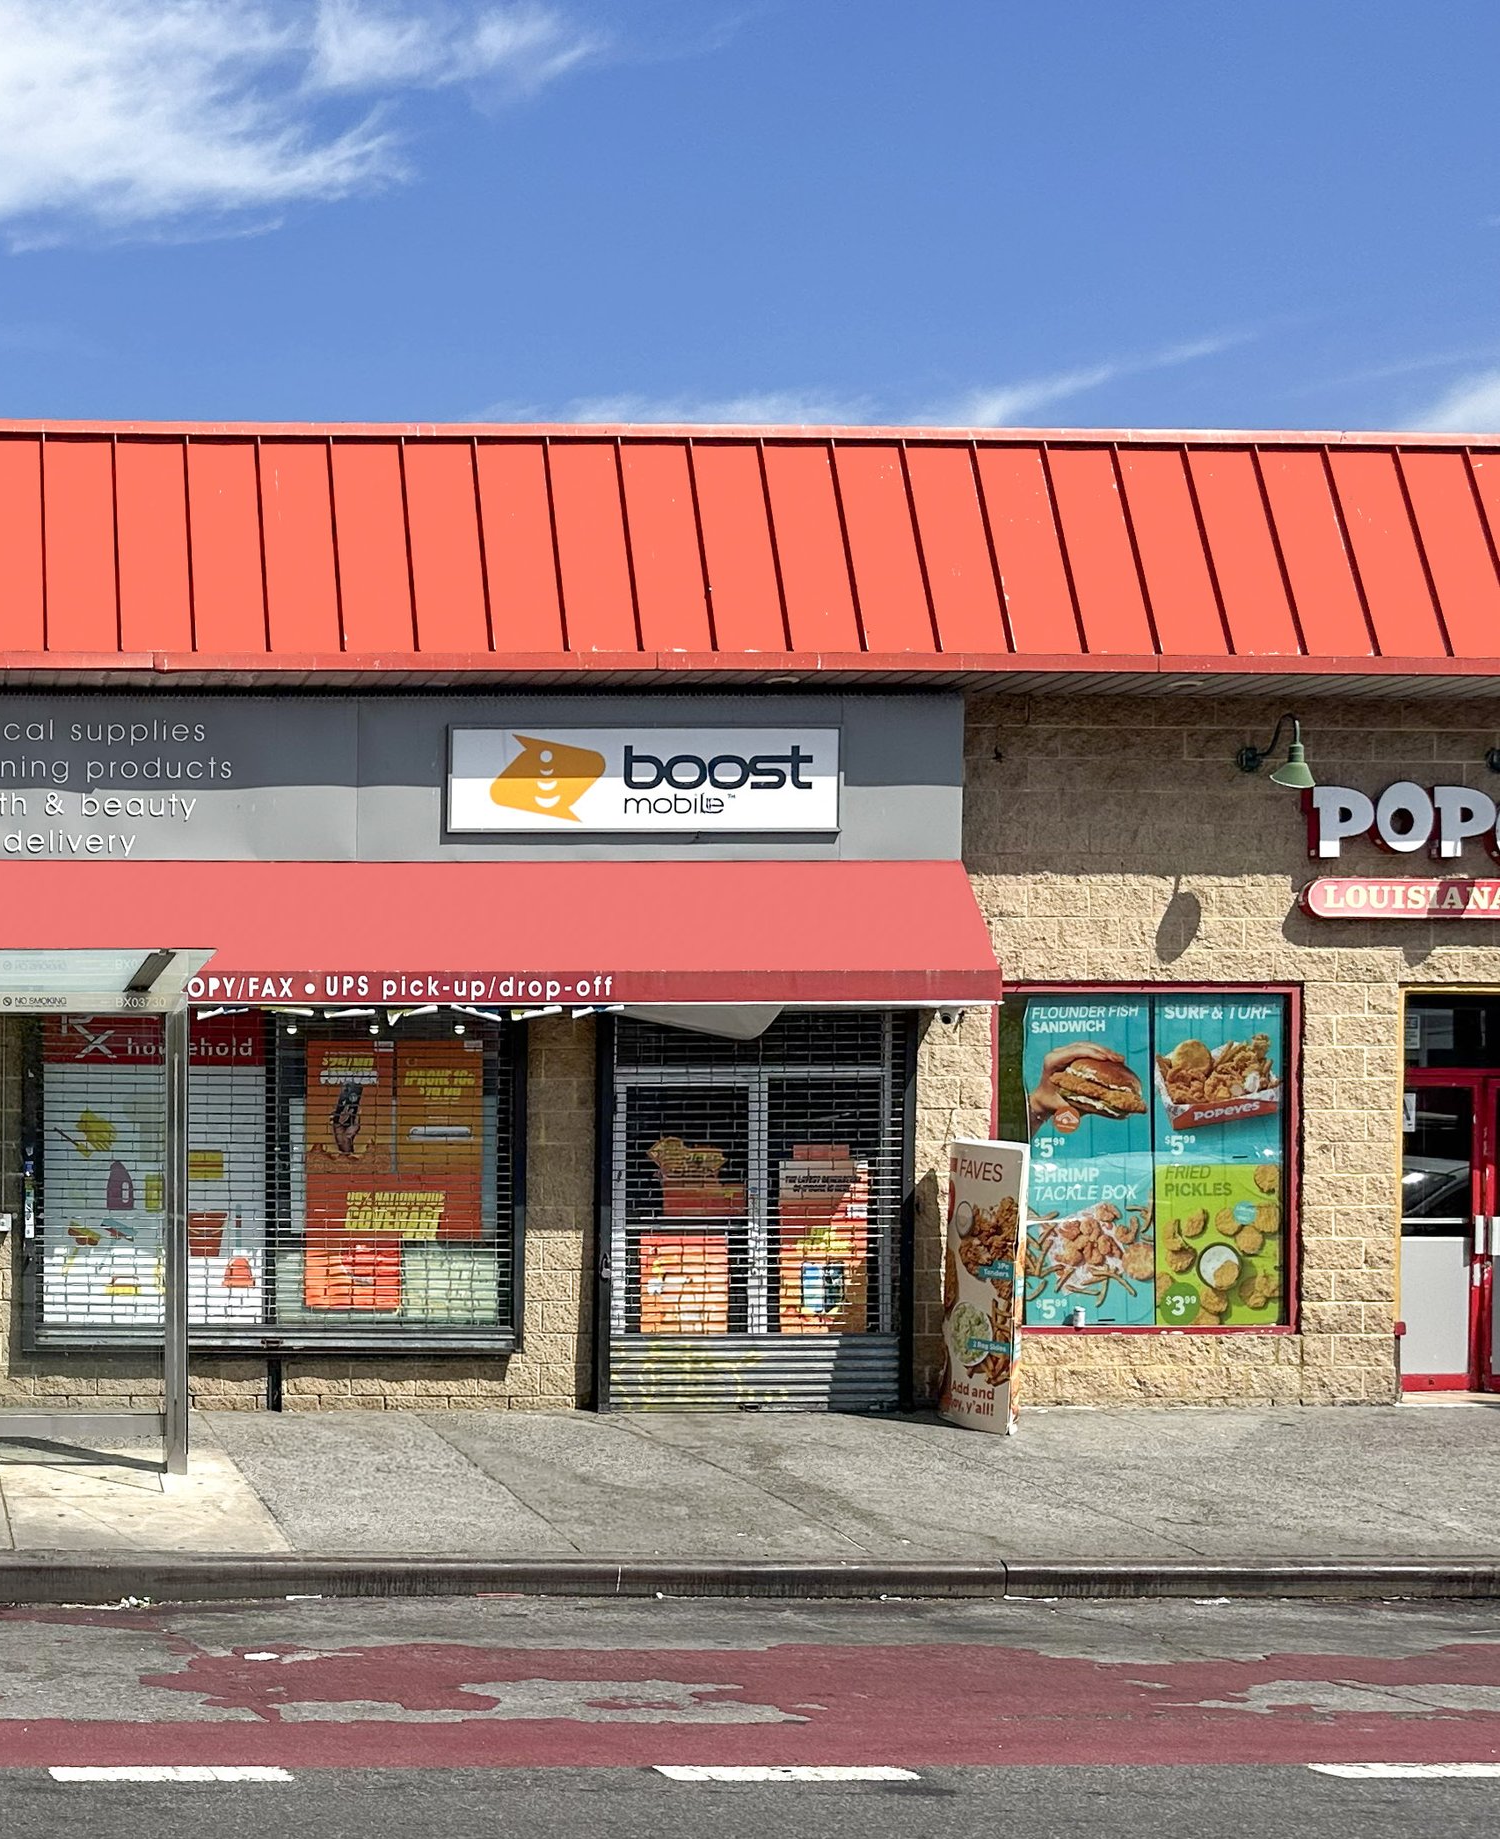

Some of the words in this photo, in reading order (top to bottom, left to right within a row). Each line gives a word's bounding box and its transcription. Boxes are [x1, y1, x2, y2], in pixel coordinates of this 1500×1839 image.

[70, 719, 206, 746] supplies
[86, 757, 233, 783] products
[624, 745, 813, 790] boost
[45, 792, 66, 817] &
[81, 792, 197, 822] beauty
[624, 793, 725, 814] mobile
[1313, 781, 1500, 857] POP
[4, 831, 137, 857] delivery
[183, 976, 293, 999] OPY/FAX
[326, 976, 369, 997] UPS
[383, 975, 613, 1000] pick-up/drop-off
[116, 997, 166, 1008] BX03730
[1031, 1006, 1106, 1019] FLOUNDER
[1108, 1005, 1139, 1018] FISH
[1164, 1005, 1209, 1019] SURF
[1211, 1005, 1223, 1019] &
[1229, 1004, 1272, 1019] TURF
[1031, 1020, 1106, 1033] SANDWICH
[127, 1037, 253, 1057] houehold
[960, 1159, 1003, 1183] FAVES
[1034, 1167, 1099, 1184] SHRIMP
[1165, 1165, 1211, 1180] FRIED
[1035, 1184, 1098, 1201] TACKLE
[1101, 1184, 1138, 1199] BOX
[1165, 1183, 1232, 1198] PICKLES
[952, 1380, 969, 1396] Add
[972, 1387, 995, 1400] and
